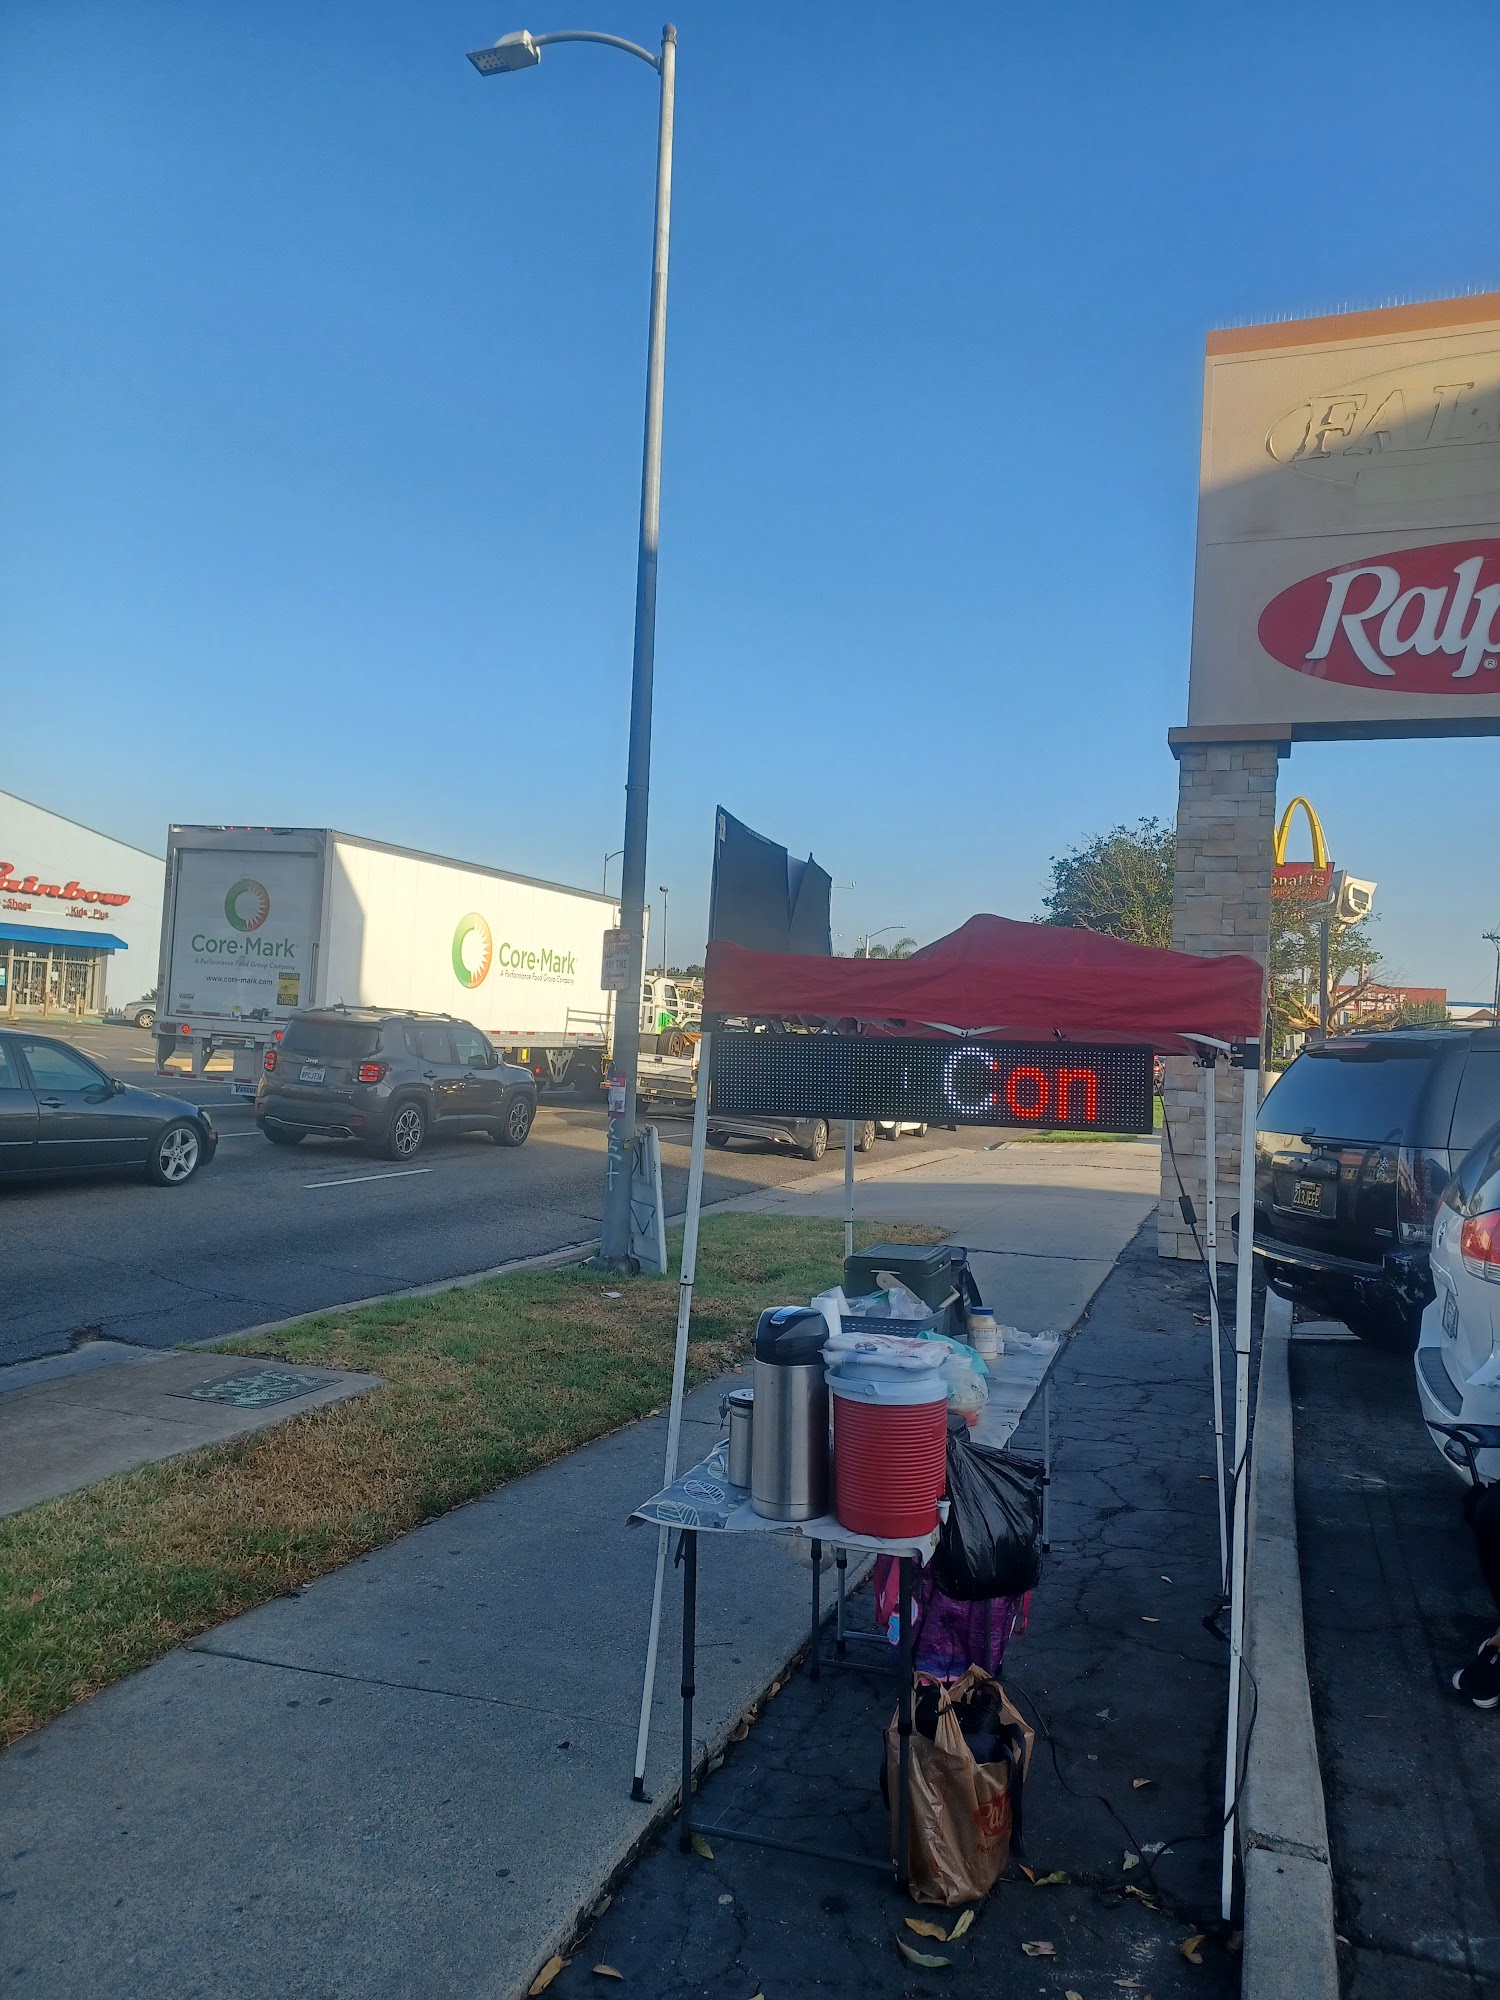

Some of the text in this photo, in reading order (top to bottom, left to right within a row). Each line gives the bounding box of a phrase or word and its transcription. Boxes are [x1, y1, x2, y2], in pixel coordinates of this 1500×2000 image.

[71, 906, 109, 919] Kids Plus
[200, 958, 234, 966] Performance
[234, 959, 249, 967] Food
[250, 961, 268, 970] Group
[269, 962, 296, 971] Company
[206, 975, 273, 985] www.core-mark.com
[504, 969, 531, 980] Performance
[532, 972, 543, 981] Food
[543, 973, 556, 984] Group
[556, 975, 574, 986] Company
[305, 1057, 318, 1065] Jeep
[944, 1047, 1097, 1121] Con
[1293, 1188, 1320, 1207] 213JEFE
